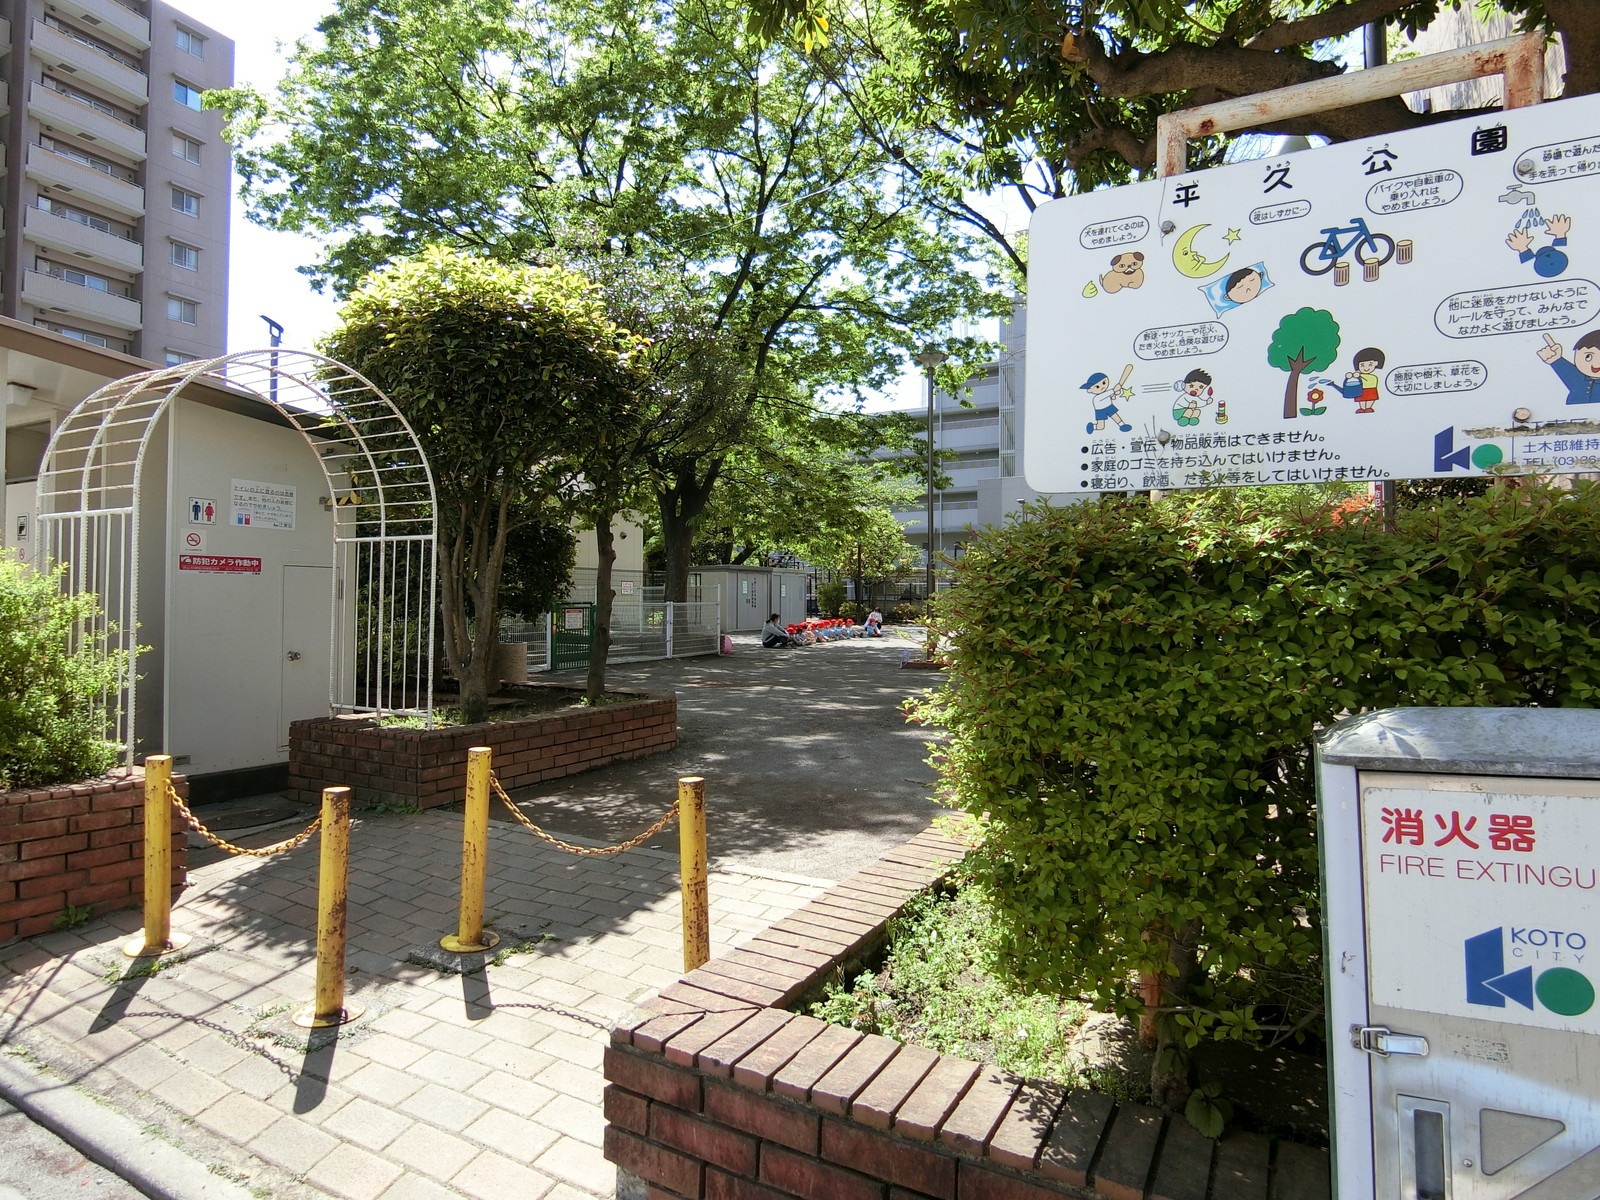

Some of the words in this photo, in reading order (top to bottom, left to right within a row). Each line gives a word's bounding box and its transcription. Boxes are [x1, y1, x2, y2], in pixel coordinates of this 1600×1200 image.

[1374, 172, 1455, 195] バイクや自転車の
[1389, 186, 1440, 202] 乗り入れは
[1084, 221, 1144, 238] 犬を連れてくるのは
[1448, 286, 1588, 311] 他に迷惑をかけないように
[1448, 299, 1588, 324] ルールを守って、みんなで
[1394, 366, 1480, 382] 施設や樹木、草花を
[1091, 430, 1326, 455] 広告・宣伝物品販売はできません。
[1091, 448, 1342, 473] 家庭のゴミを持ち込んではいけません。
[192, 557, 259, 567] 防犯カメラ作動中
[1380, 807, 1536, 853] 消火器
[1380, 853, 1445, 878] FIRE
[1510, 927, 1587, 950] KOTO
[1511, 947, 1585, 964] CITY
